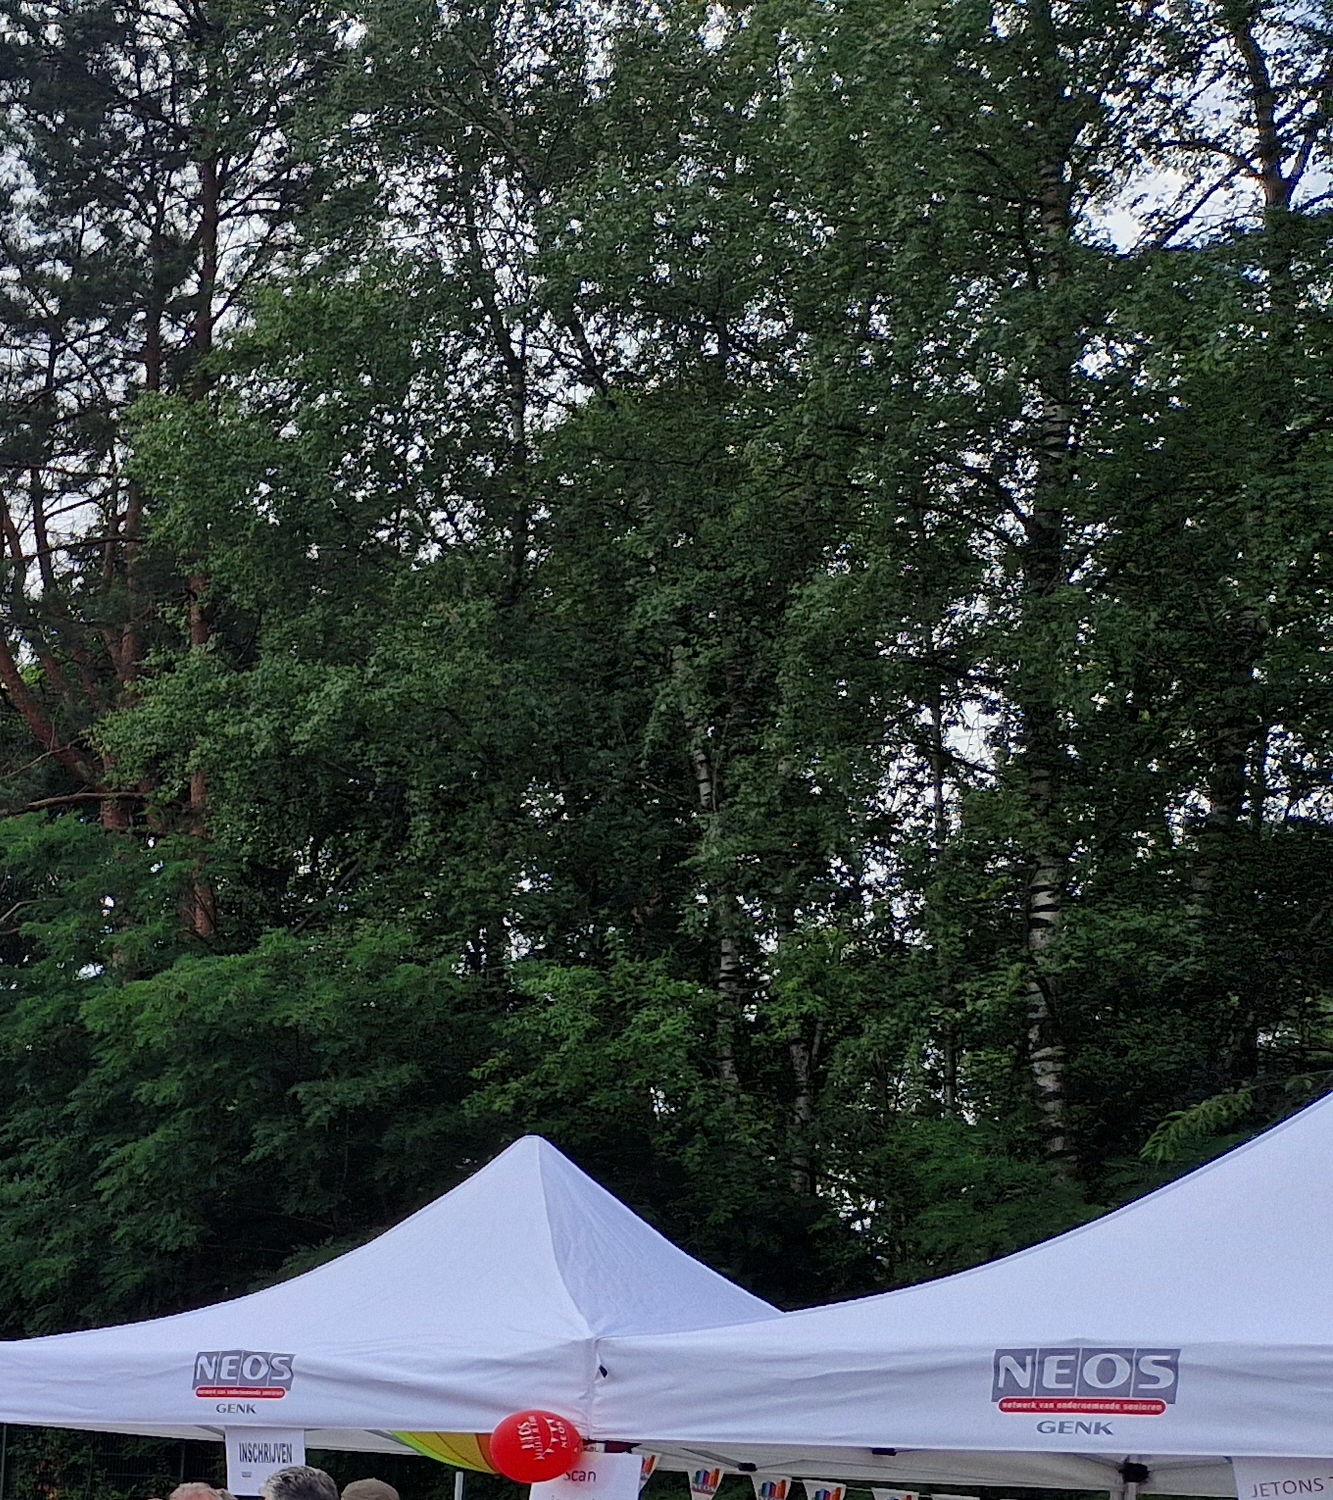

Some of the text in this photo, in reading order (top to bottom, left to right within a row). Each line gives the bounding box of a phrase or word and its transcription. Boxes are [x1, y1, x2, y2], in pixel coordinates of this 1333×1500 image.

[196, 1354, 293, 1381] NEOS
[997, 1353, 1175, 1390] NEOS
[215, 1403, 257, 1414] GENK
[1036, 1420, 1114, 1436] GENK
[238, 1442, 293, 1464] INSCHRIJVEN
[1251, 1477, 1324, 1498] JETONS
